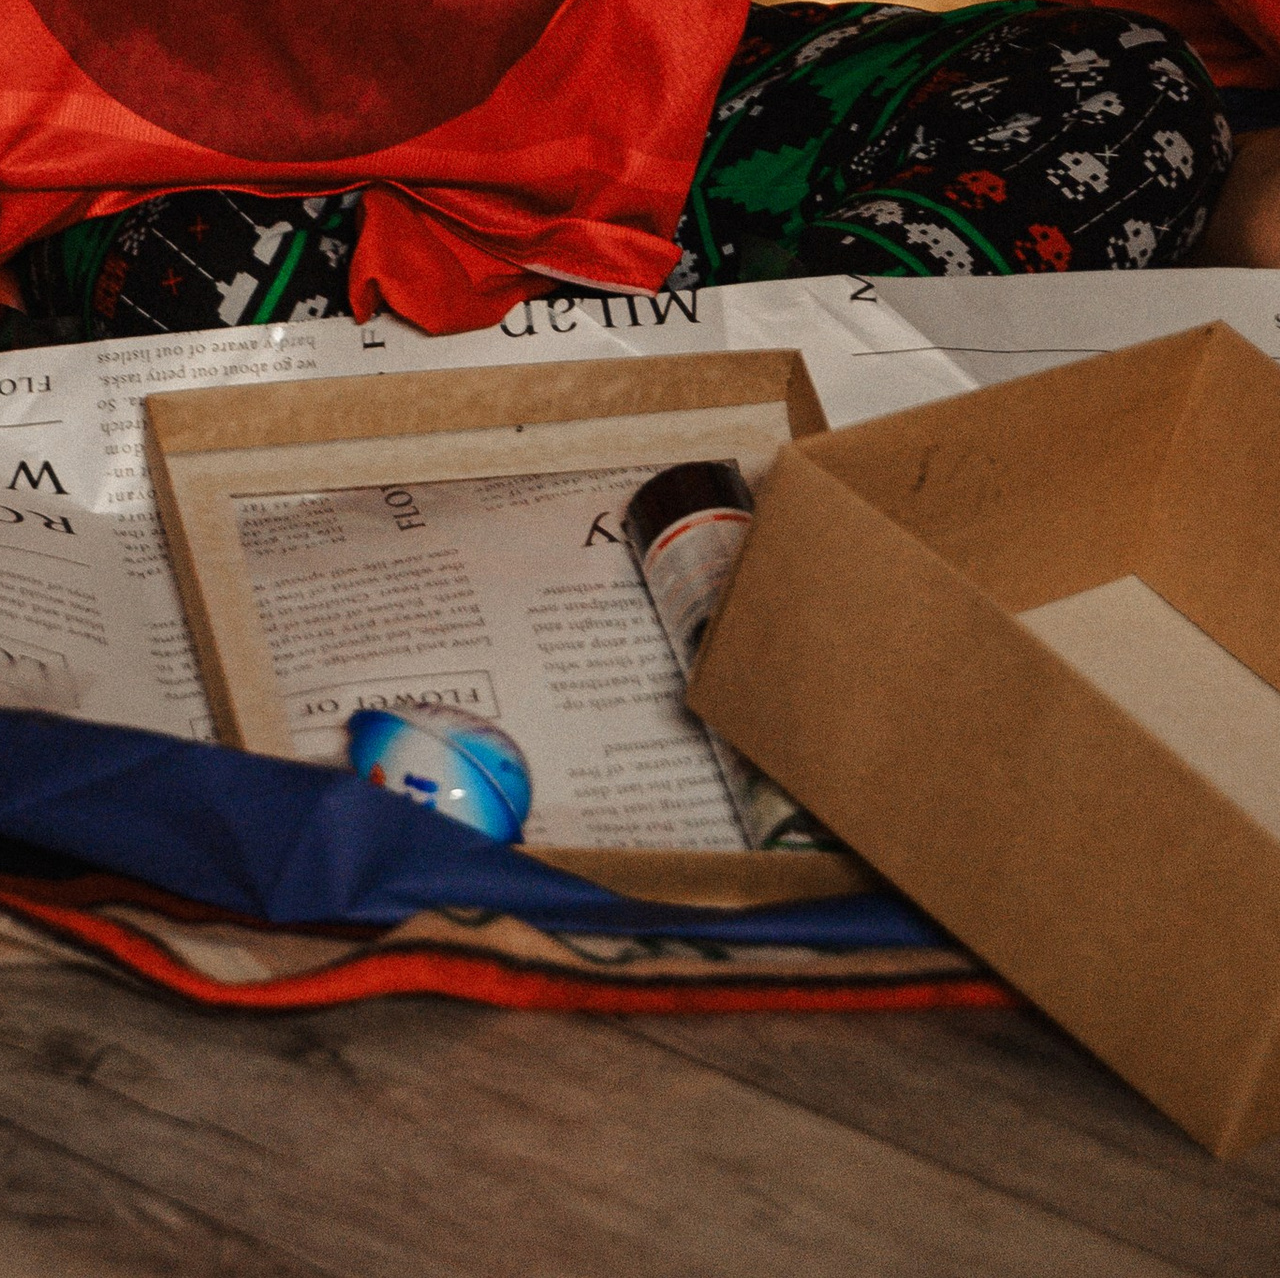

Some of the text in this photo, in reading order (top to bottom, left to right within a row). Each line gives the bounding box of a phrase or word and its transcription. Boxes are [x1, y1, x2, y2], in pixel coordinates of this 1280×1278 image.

[187, 344, 206, 358] of
[212, 340, 258, 354] aware
[96, 348, 151, 367] listless
[272, 356, 292, 371] go
[297, 359, 317, 370] we
[146, 365, 185, 382] petty
[222, 362, 268, 379] about
[380, 485, 426, 532] FLO
